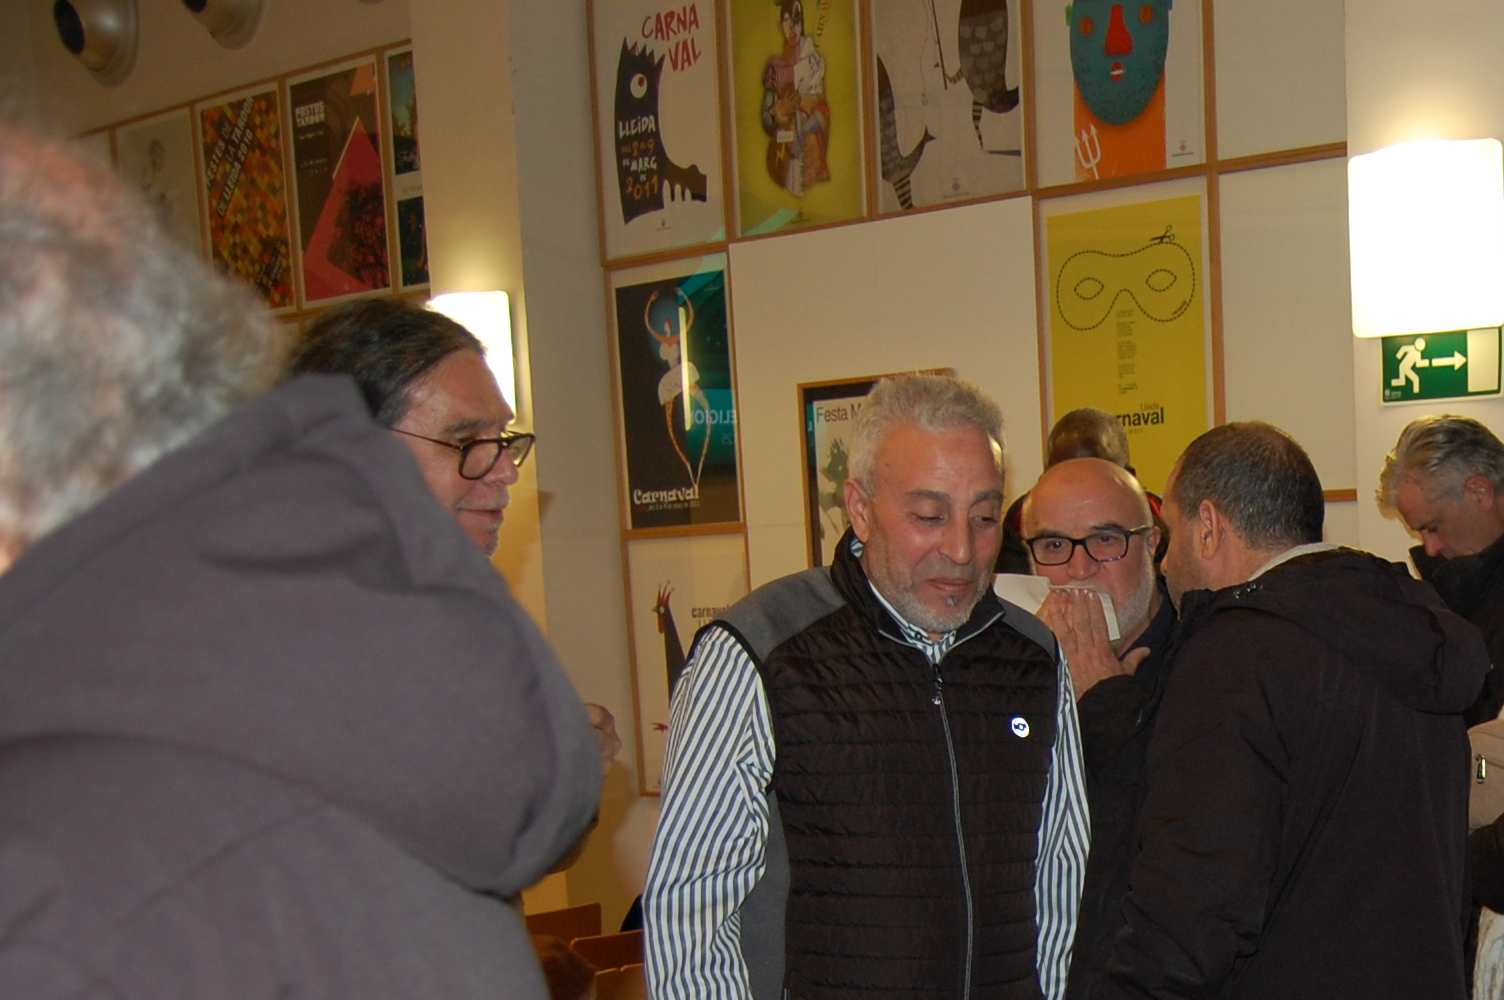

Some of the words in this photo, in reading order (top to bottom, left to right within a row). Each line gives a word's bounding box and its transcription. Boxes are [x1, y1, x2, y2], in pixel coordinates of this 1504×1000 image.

[641, 3, 700, 42] CARNA
[668, 37, 702, 72] VAL
[816, 406, 848, 423] Festa
[633, 487, 699, 505] Carnaval
